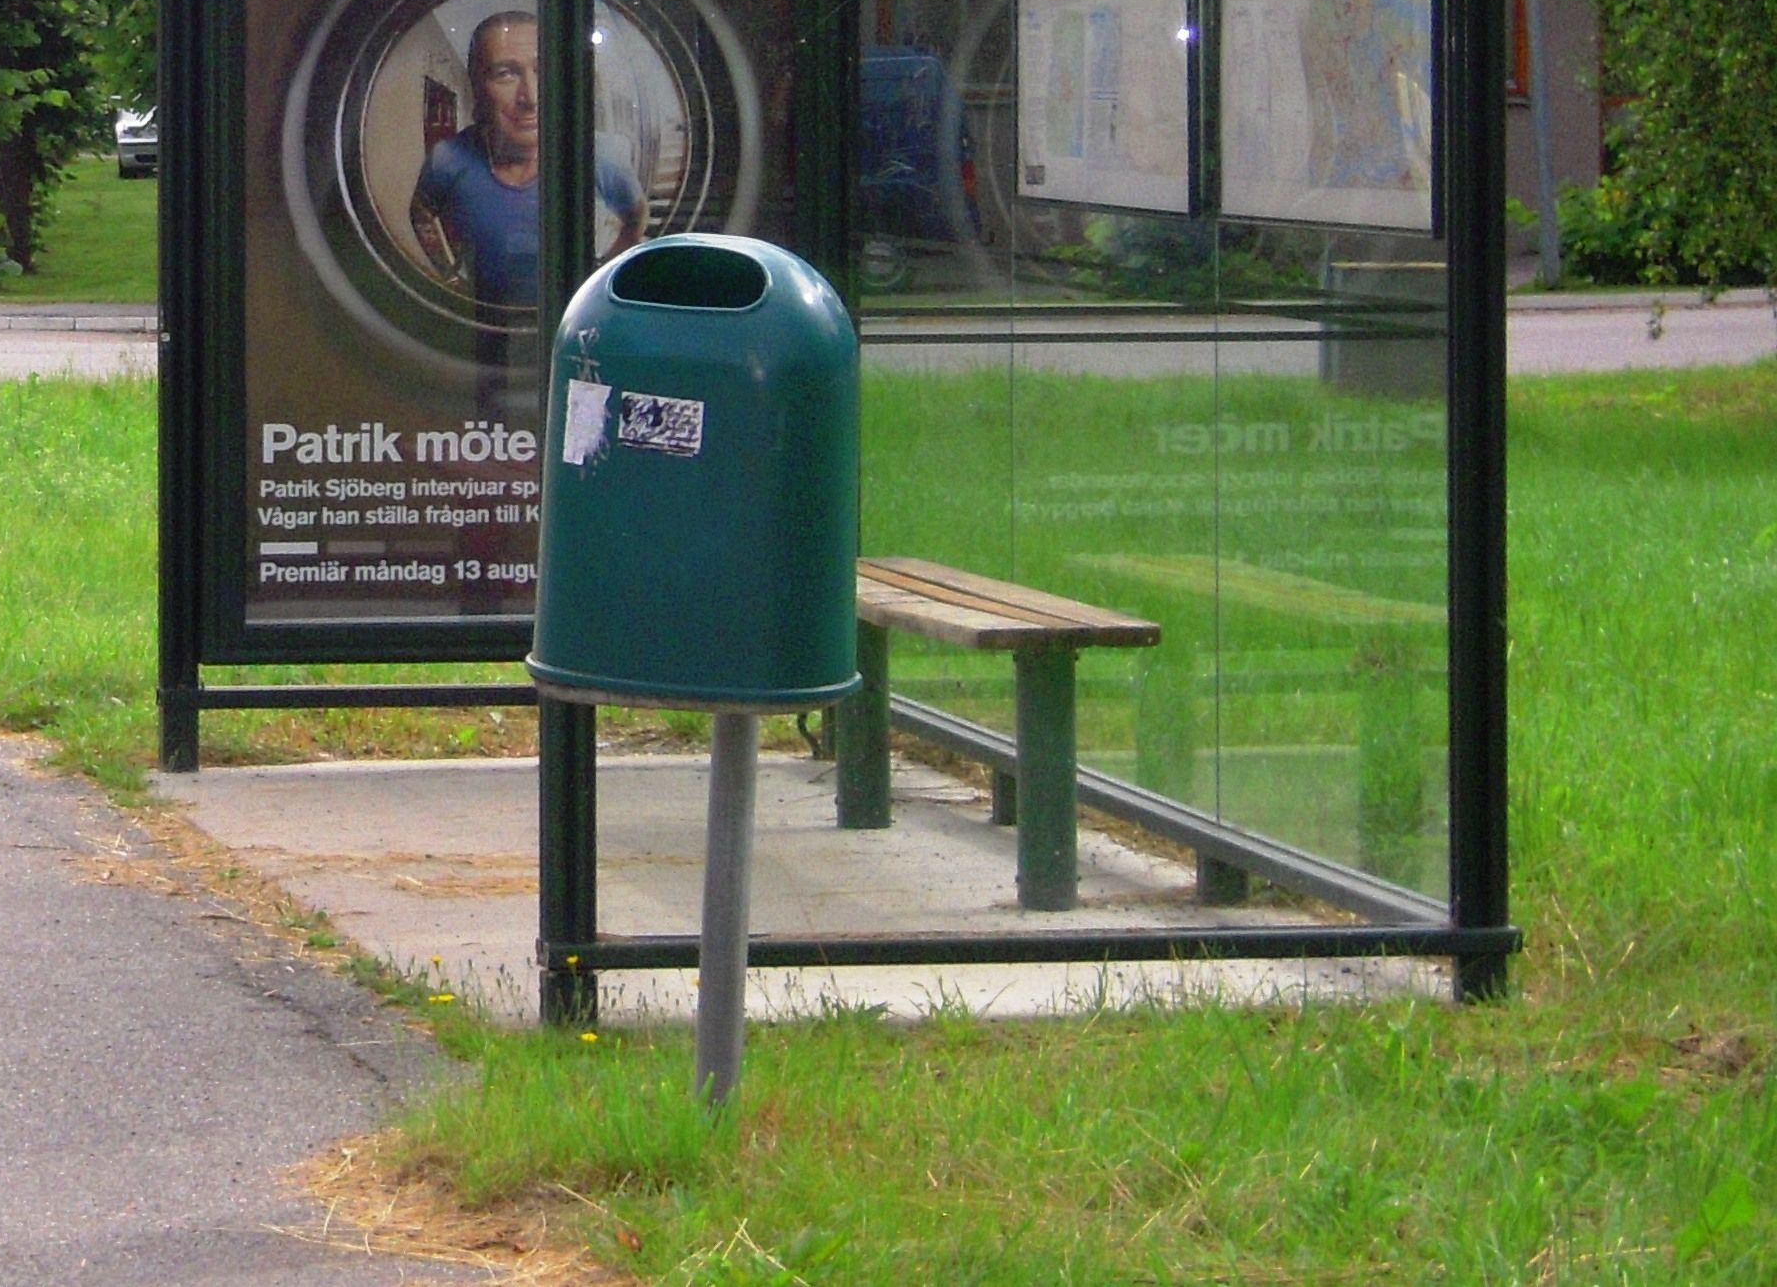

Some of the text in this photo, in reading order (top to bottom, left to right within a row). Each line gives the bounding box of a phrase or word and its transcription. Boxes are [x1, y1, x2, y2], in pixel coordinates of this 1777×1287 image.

[262, 420, 537, 464] Patrik möte
[260, 479, 321, 498] Patrik
[325, 478, 406, 501] Sjöberg
[412, 477, 506, 500] intervjuar
[257, 506, 318, 530] Vågar
[322, 506, 360, 525] han
[365, 505, 420, 525] ställa
[425, 504, 490, 527] frågan
[495, 504, 520, 523] till
[260, 560, 349, 583] Premiär
[355, 559, 446, 585] måndag
[454, 560, 482, 580] 13
